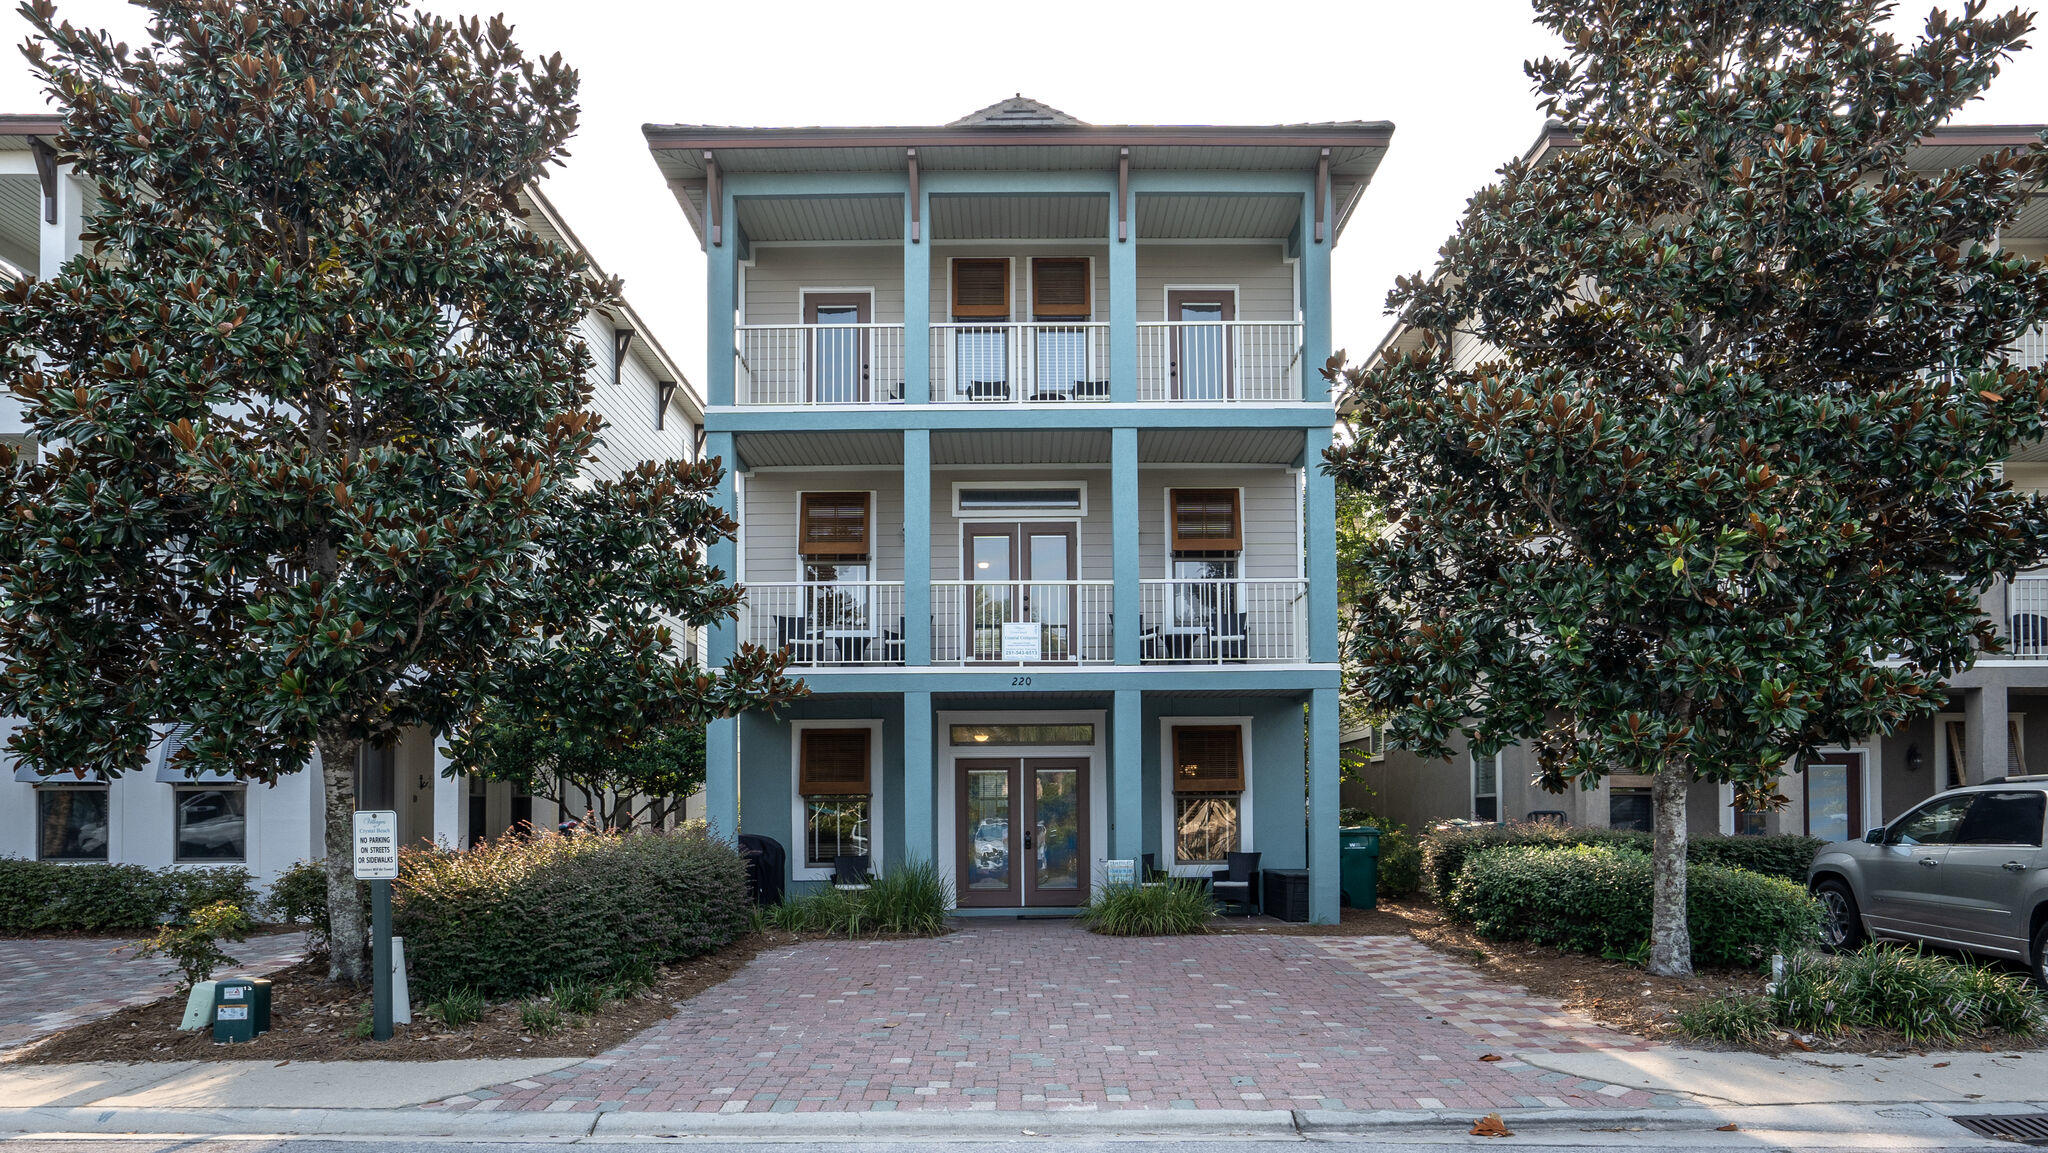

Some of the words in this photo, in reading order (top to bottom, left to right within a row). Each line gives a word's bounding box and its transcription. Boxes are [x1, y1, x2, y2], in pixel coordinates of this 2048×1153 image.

[1012, 676, 1032, 686] 220
[363, 817, 386, 827] Villages
[369, 836, 390, 844] PARKING
[357, 856, 365, 864] OR
[366, 856, 394, 864] SIDEWALKS
